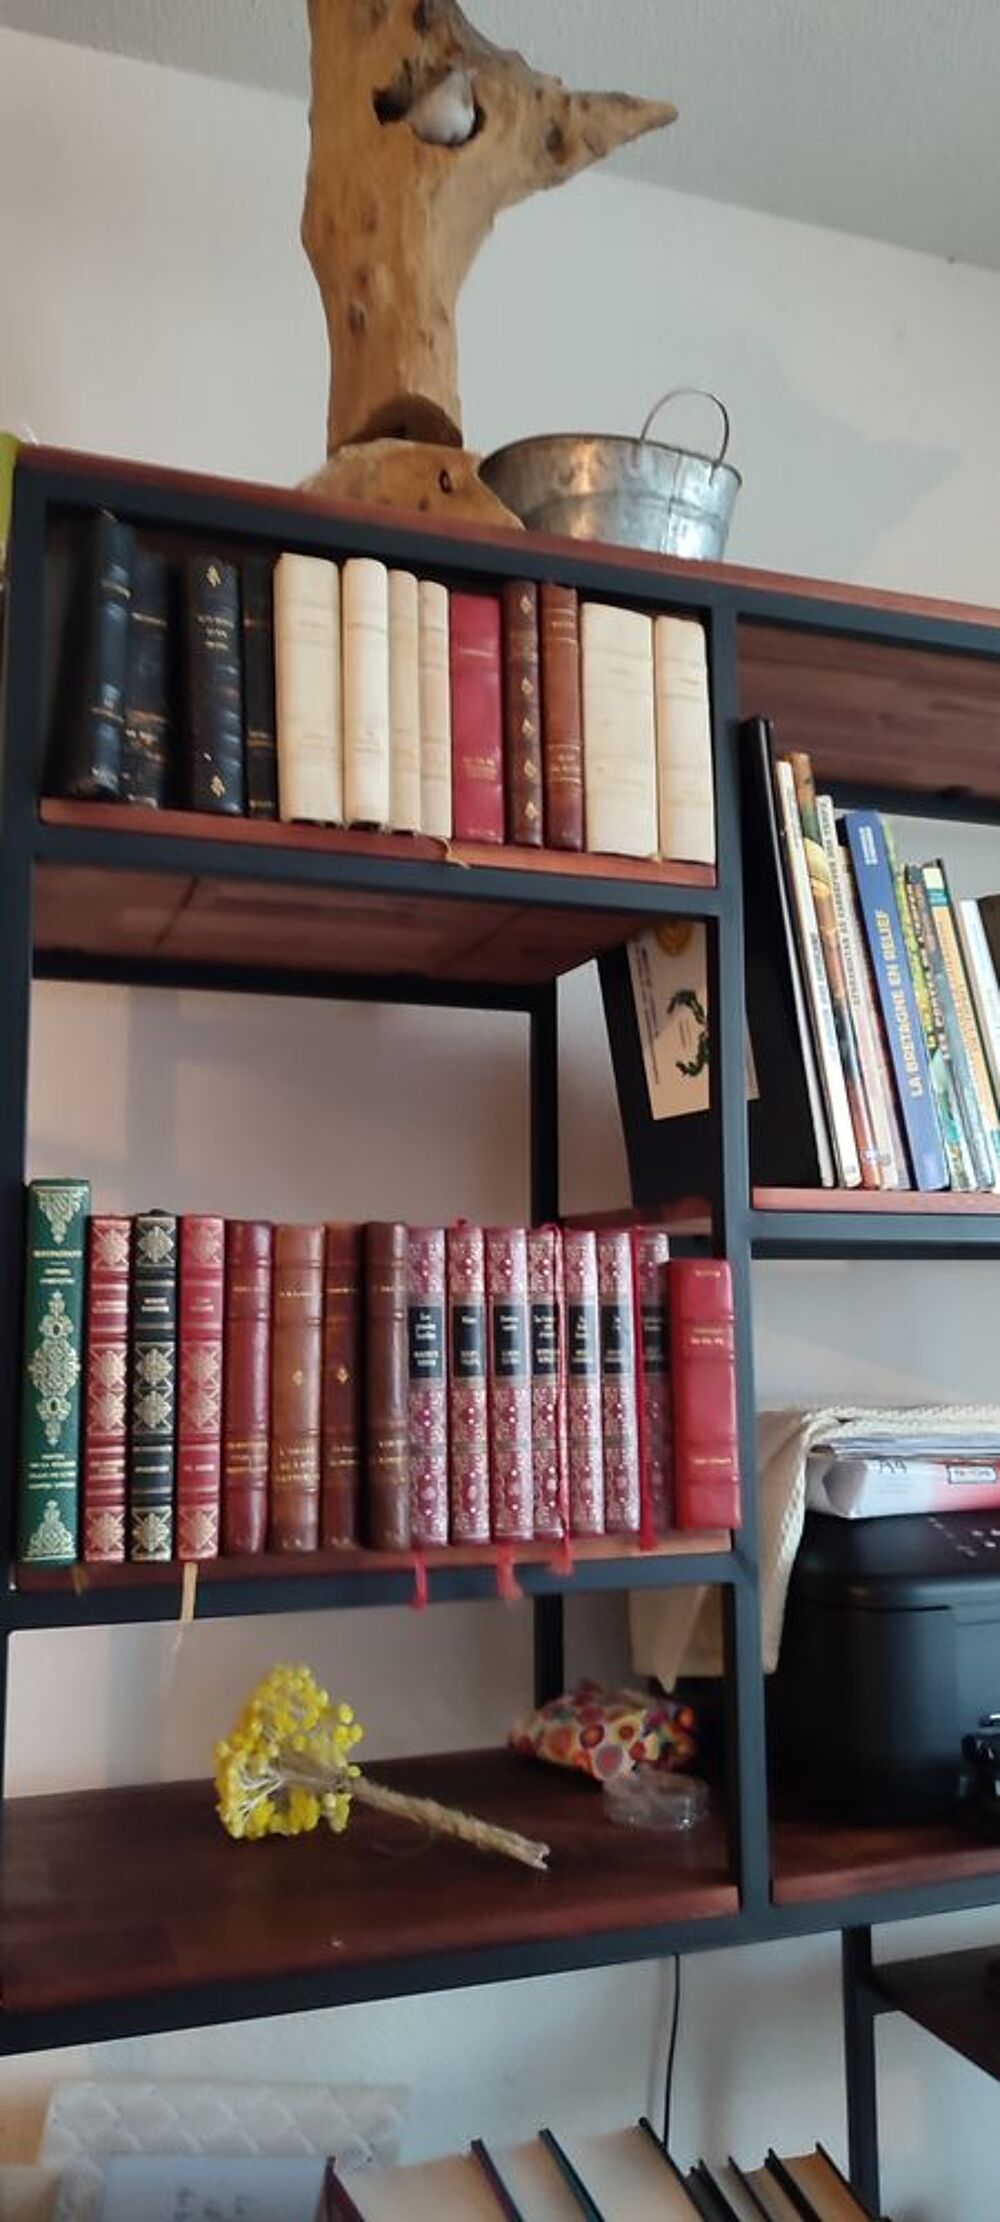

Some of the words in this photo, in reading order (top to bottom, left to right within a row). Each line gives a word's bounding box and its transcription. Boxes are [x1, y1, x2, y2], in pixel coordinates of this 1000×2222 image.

[876, 910, 896, 960] RELIEF
[886, 964, 901, 986] EN
[893, 989, 919, 1073] BRETAGNE
[908, 1077, 922, 1096] LA
